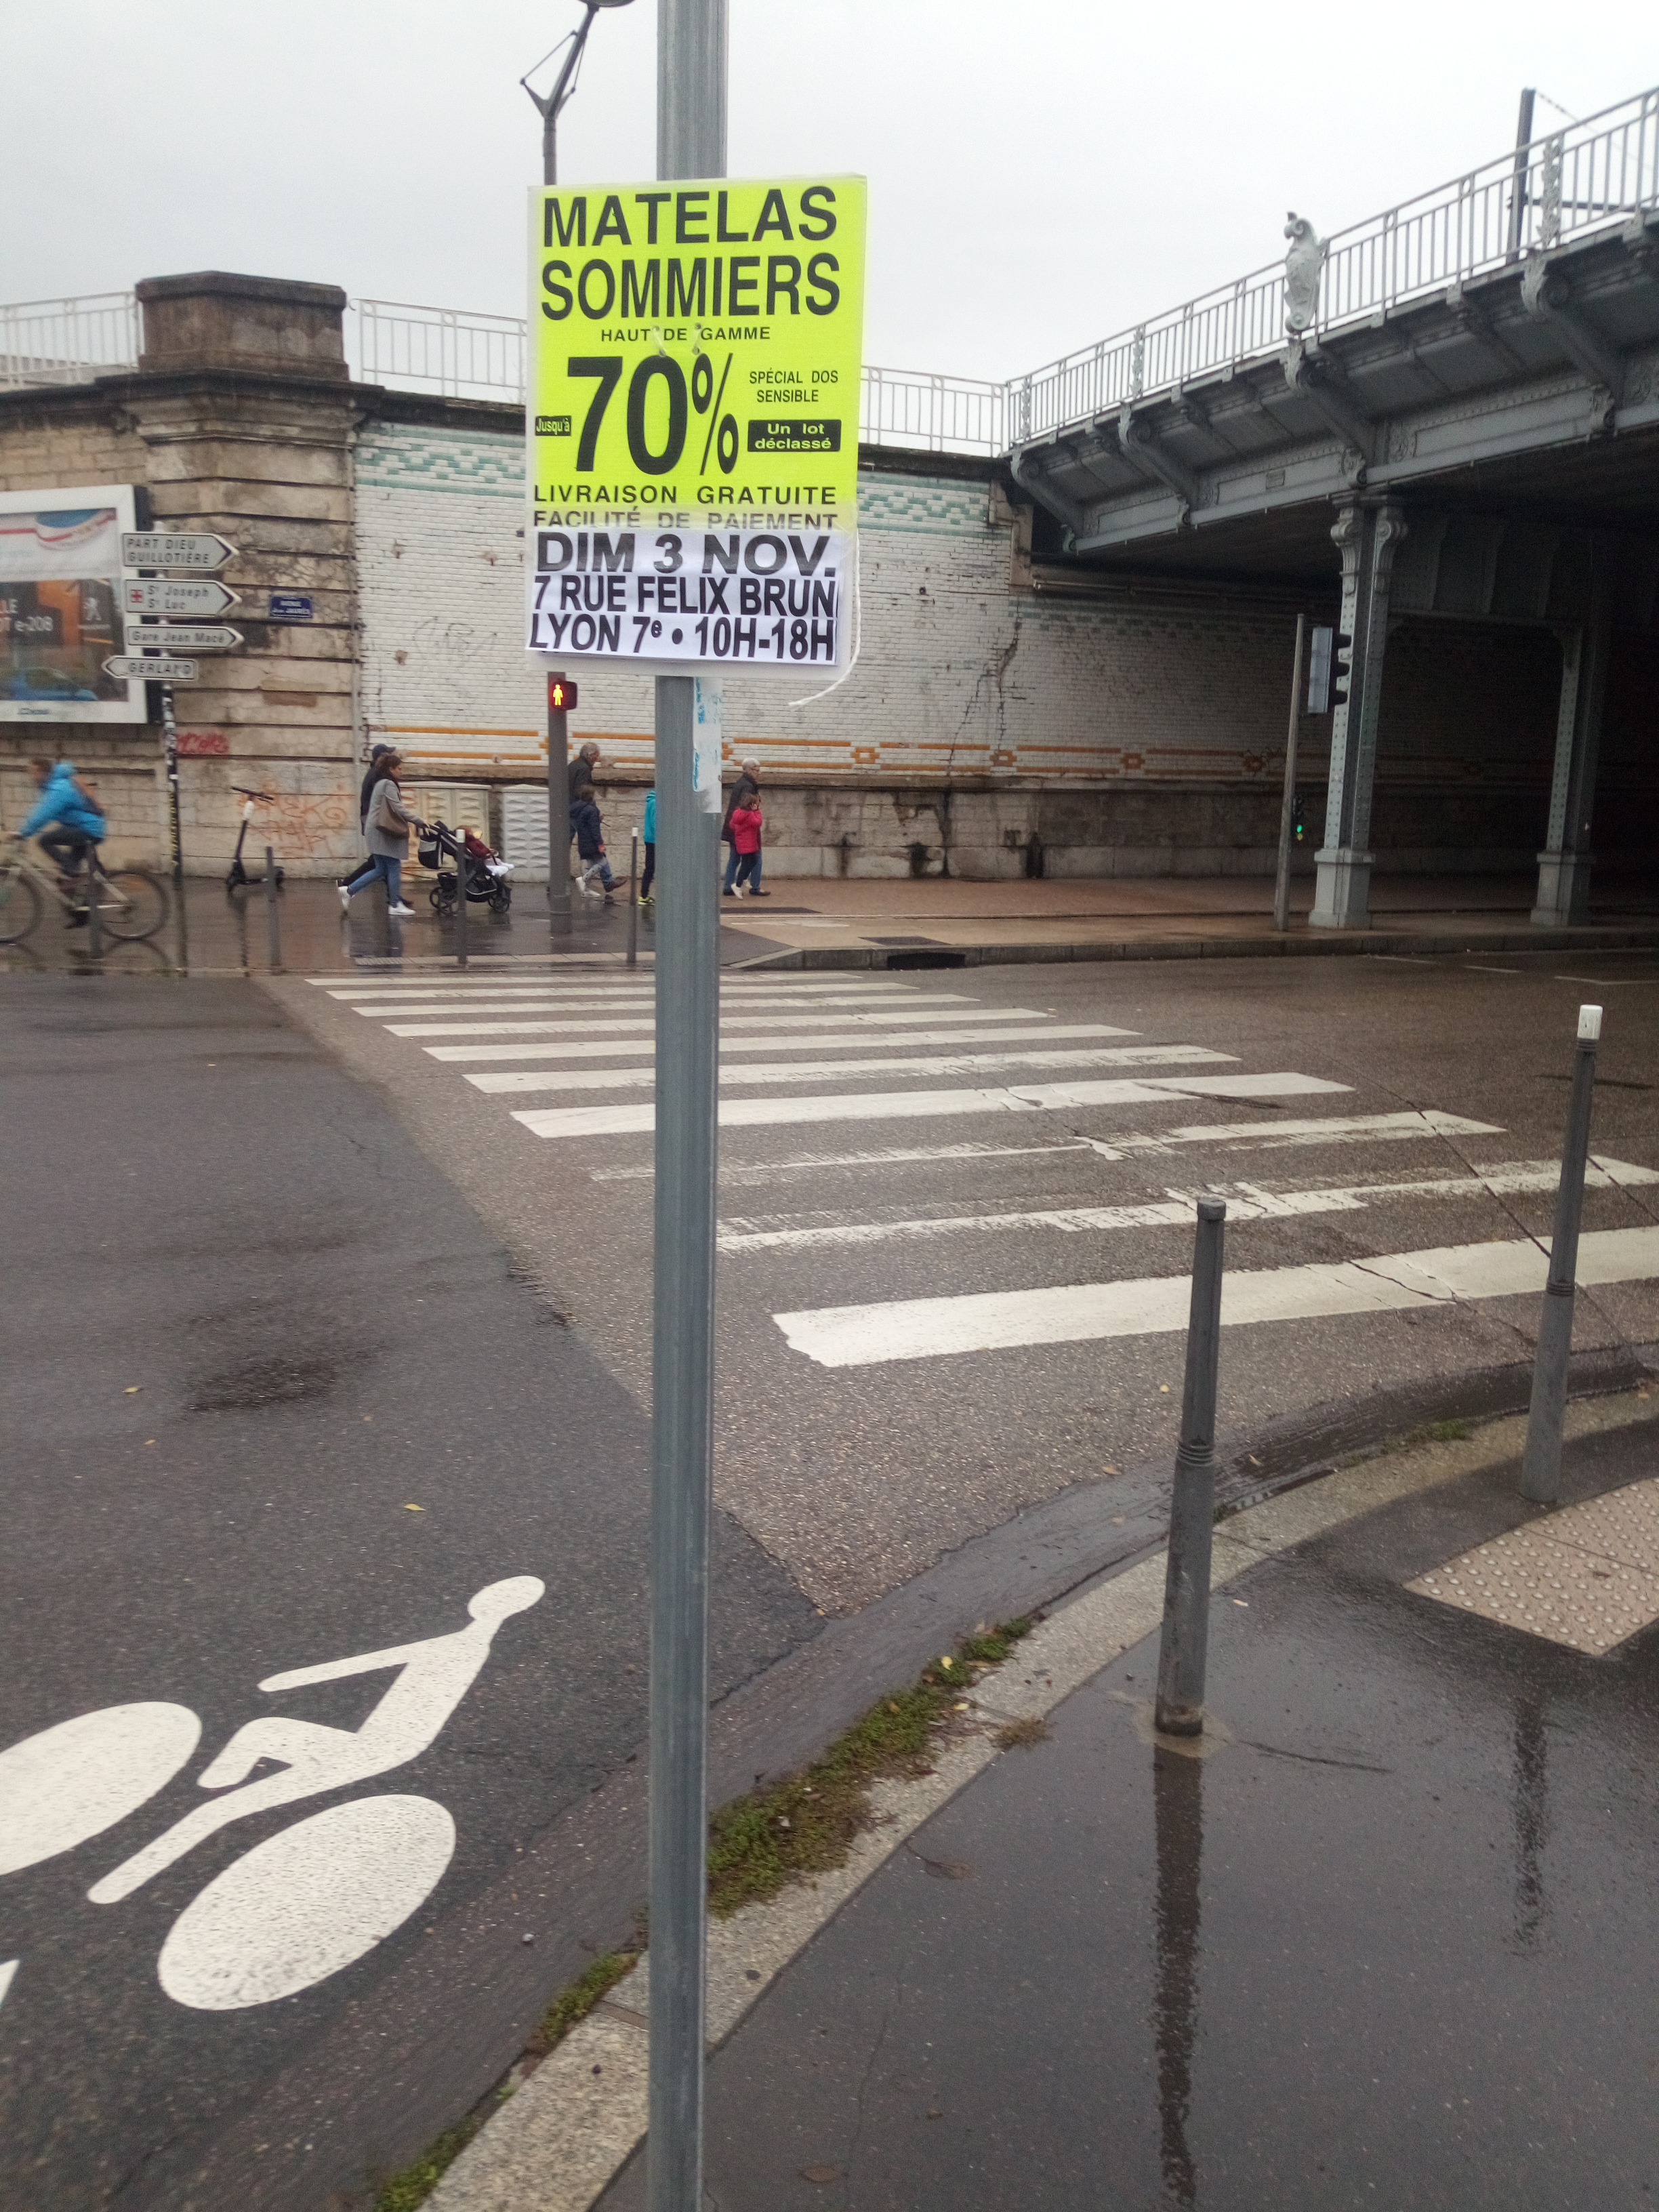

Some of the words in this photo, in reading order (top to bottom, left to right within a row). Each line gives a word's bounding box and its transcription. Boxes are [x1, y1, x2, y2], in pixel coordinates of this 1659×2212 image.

[544, 186, 838, 247] MATELAS
[542, 253, 840, 320] SOMMIERS
[601, 329, 651, 342] HAUT
[663, 328, 688, 341] DE
[701, 327, 771, 340] GAMME
[749, 367, 803, 384] SPÉCIAL
[812, 370, 838, 383] DOS
[757, 390, 819, 402] SENSIBLE
[567, 353, 739, 475] 70%
[536, 417, 570, 435] Jusqu'à
[767, 423, 791, 434] Un
[802, 423, 825, 434] lot
[755, 437, 832, 449] déclassé
[534, 485, 676, 504] LIVRAISON
[697, 486, 836, 504] GRATUITE
[534, 506, 640, 528] FACILITÉ
[658, 513, 691, 528] DE
[708, 512, 838, 530] PAIEMENT
[127, 538, 159, 549] PART
[165, 539, 195, 550] DIEU
[537, 532, 635, 573] DIM
[653, 534, 683, 573] 3
[702, 534, 836, 577] NOV.
[165, 586, 209, 598] Joseph
[535, 575, 550, 610] 7
[560, 575, 626, 612] RUE
[638, 576, 731, 615] FELIX
[740, 577, 836, 617] BRUN
[165, 599, 186, 609] Luc
[132, 631, 159, 641] Gare
[163, 632, 190, 642] Jean
[529, 613, 620, 651] LYON
[695, 616, 834, 661] 10H-18H
